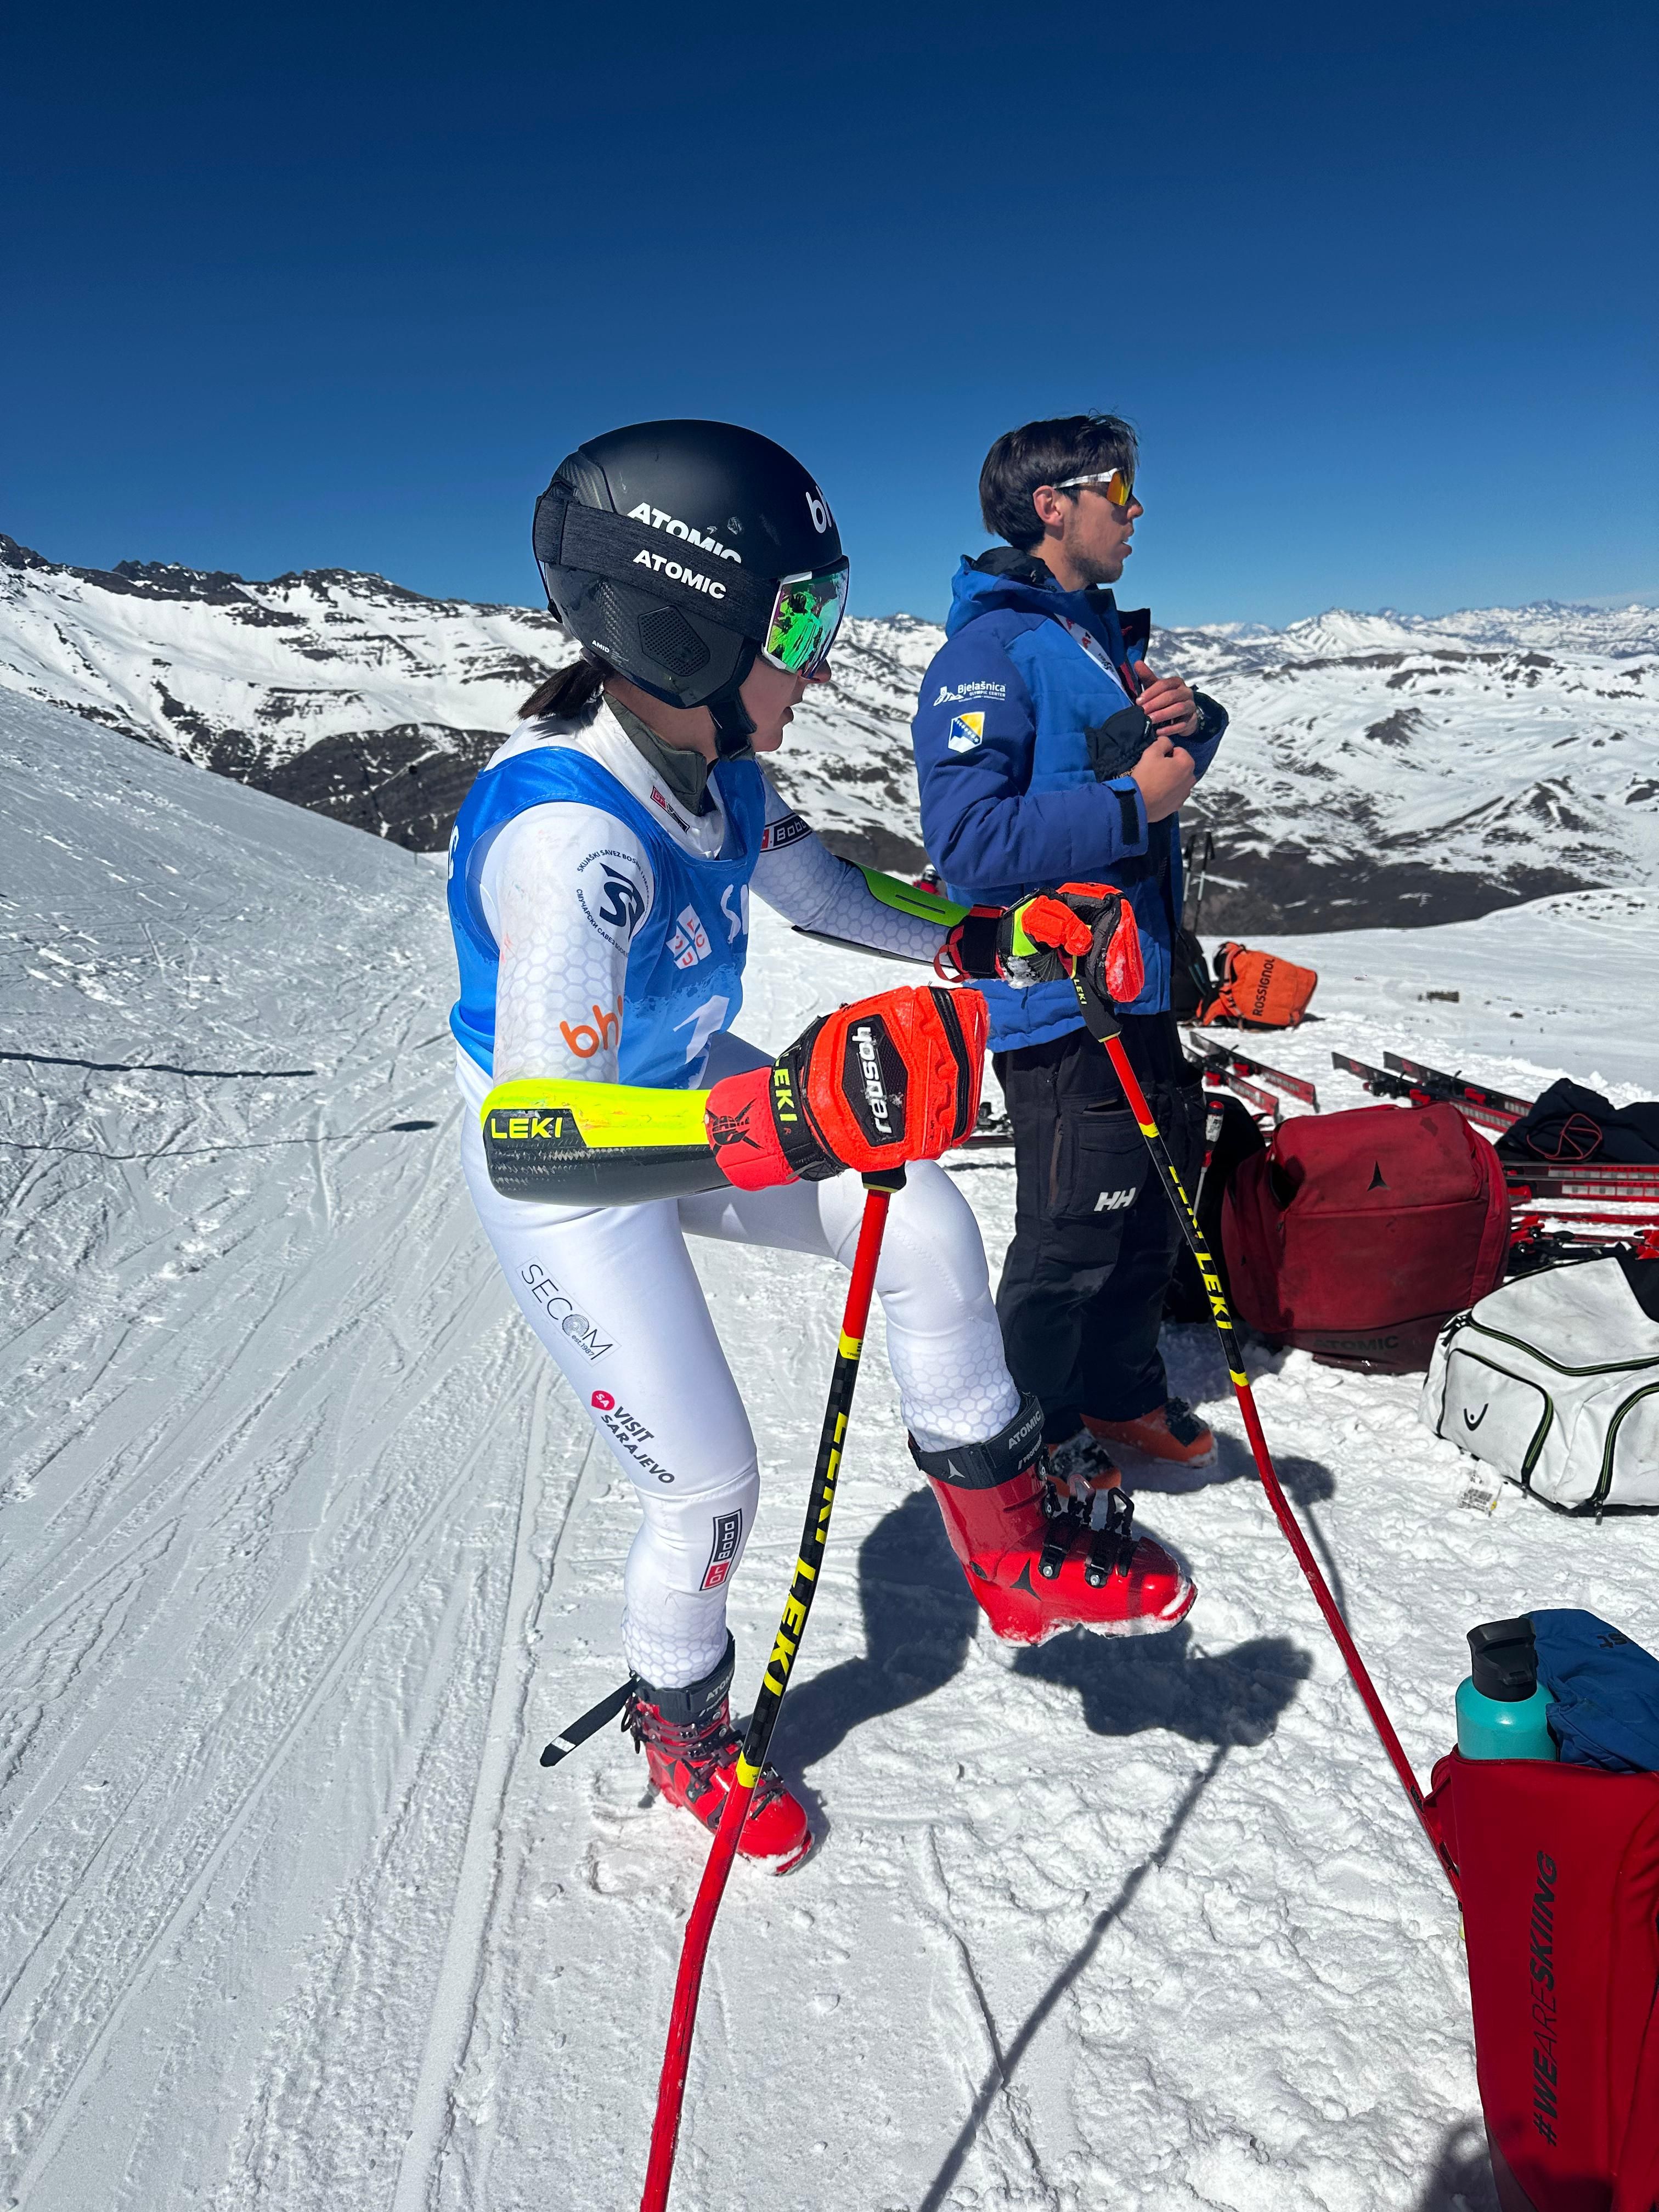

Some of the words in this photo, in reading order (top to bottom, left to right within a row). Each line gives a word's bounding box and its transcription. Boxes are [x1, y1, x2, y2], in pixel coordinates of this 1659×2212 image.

[633, 549, 726, 599] ATOMIC
[592, 640, 610, 653] AMID
[957, 681, 1006, 695] Bjelašnica
[600, 849, 622, 859] SAVEZ
[1074, 979, 1087, 1006] LEKI
[1252, 957, 1276, 1017] ROSSIGNOL
[851, 1026, 893, 1134] reusch
[490, 1117, 563, 1139] LEKI
[1094, 1187, 1137, 1212] HH
[1194, 1252, 1233, 1329] LEKI
[521, 1264, 613, 1360] SECOM
[1313, 1335, 1398, 1351] ATOMIC
[596, 1393, 610, 1408] SA
[613, 1406, 655, 1442] VISIT
[1008, 1410, 1041, 1450] ATOMIC
[601, 1414, 675, 1483] SARAJEVO
[718, 1520, 735, 1560] Bobo
[764, 1556, 816, 1697] LEKI
[1532, 1850, 1558, 2147] #WEARESKIING
